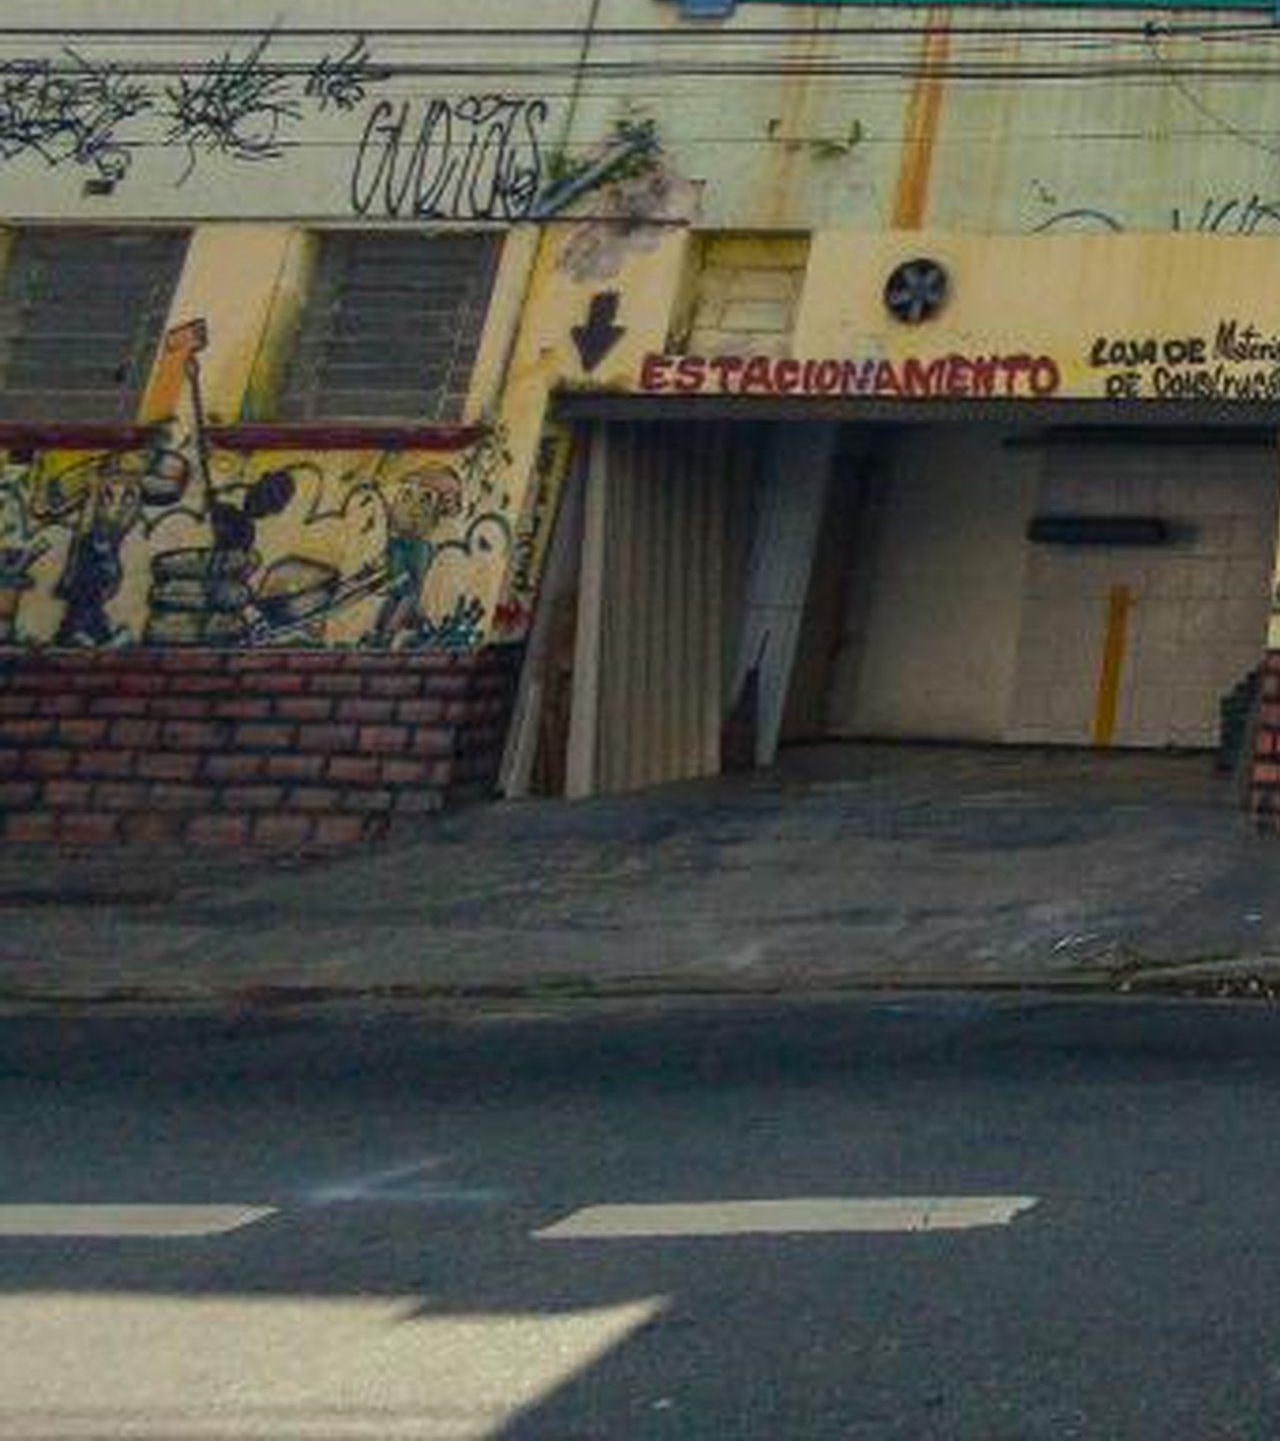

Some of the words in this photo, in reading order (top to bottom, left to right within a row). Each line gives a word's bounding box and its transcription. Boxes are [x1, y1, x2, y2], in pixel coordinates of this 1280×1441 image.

[1164, 338, 1206, 366] DE
[640, 354, 1061, 395] ESTACIONAMENTO
[1106, 373, 1142, 398] DE
